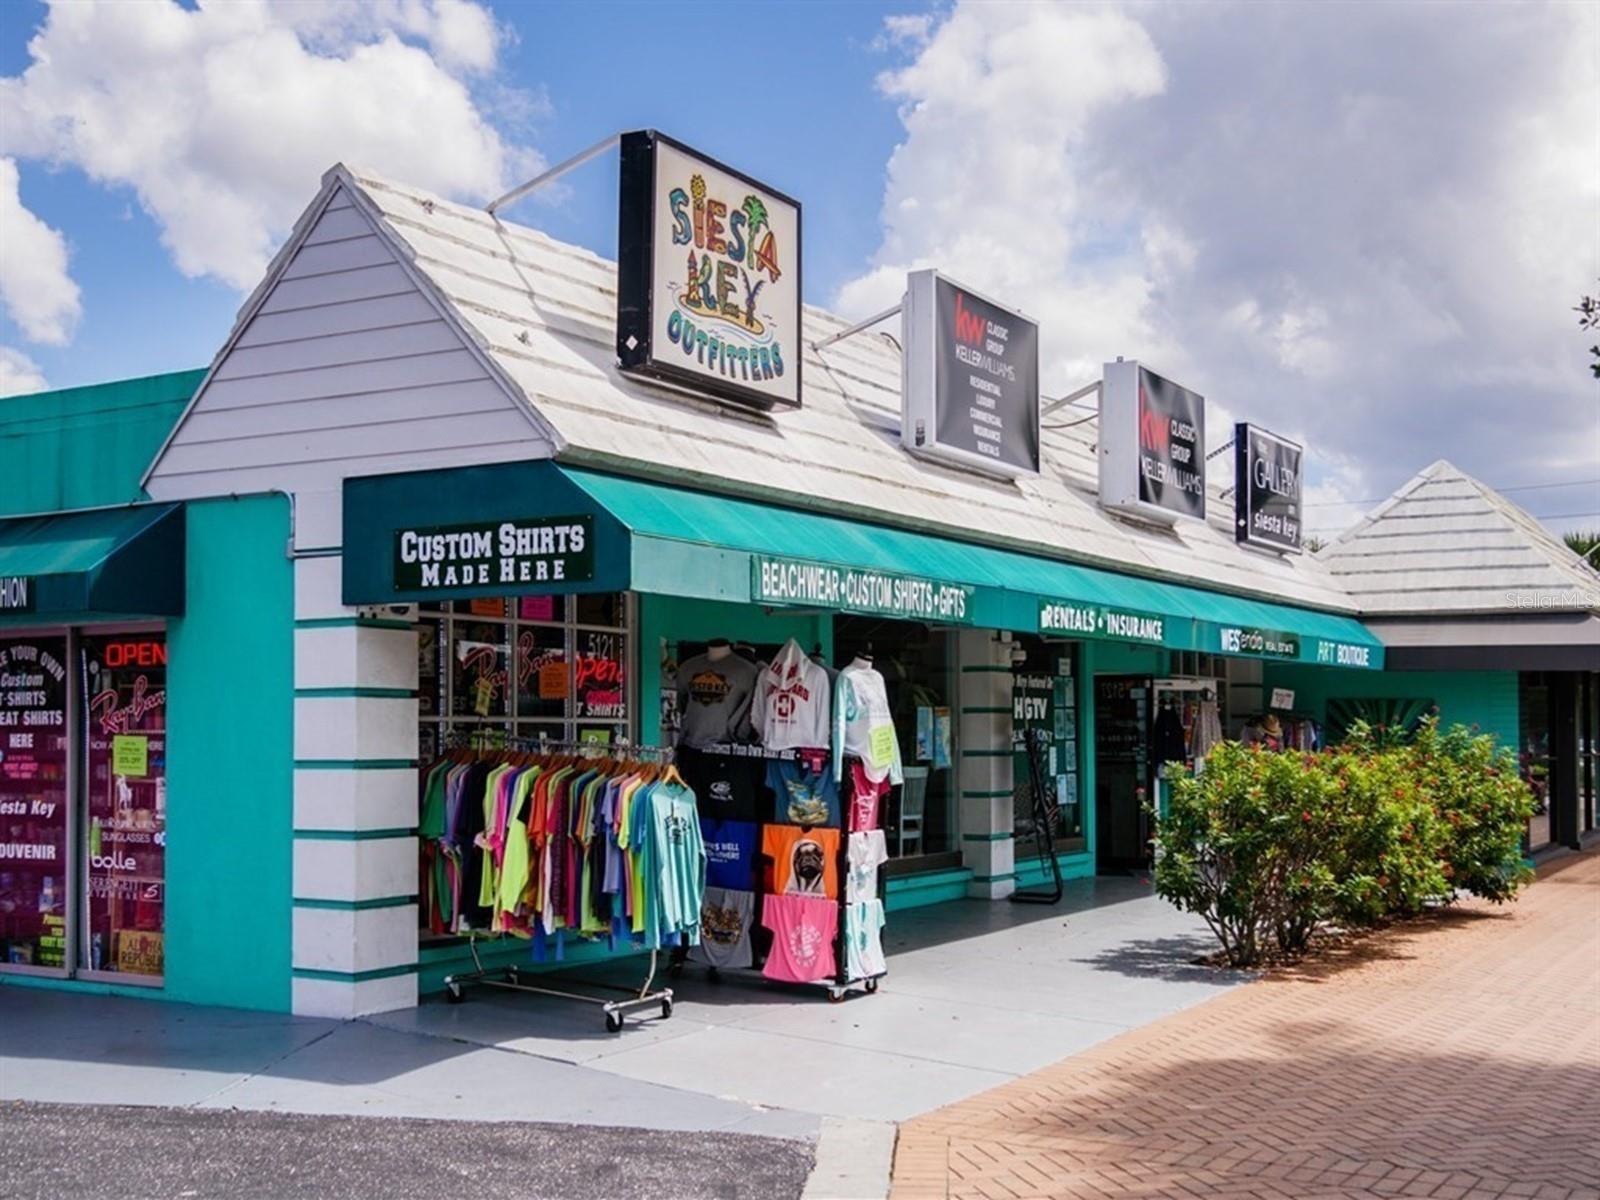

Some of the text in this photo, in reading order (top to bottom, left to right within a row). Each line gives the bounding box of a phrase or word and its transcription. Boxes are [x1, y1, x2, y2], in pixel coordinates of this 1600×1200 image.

[668, 174, 782, 284] SIESTA
[686, 249, 766, 328] KEY
[986, 320, 1009, 342] CLASSIC
[667, 309, 785, 382] OUTFITTERS
[986, 338, 1005, 356] GROUP
[1170, 418, 1197, 443] CLASSIC
[1170, 443, 1192, 464] GROUP
[1253, 508, 1298, 543] siesta key
[846, 572, 893, 609] CUSTOM
[894, 579, 933, 614] SHIRTS
[939, 588, 966, 619] GIFTS
[1045, 604, 1164, 641] RENTALS INSURANCE
[105, 642, 167, 667] OPEN
[588, 633, 614, 660] 5121
[1316, 640, 1370, 667] ART BOUTIQUE
[10, 645, 38, 661] YOUR
[40, 651, 65, 682] OWN
[1, 672, 44, 688] Custom
[23, 709, 63, 726] SHIRTS
[1014, 696, 1049, 719] HGTV
[9, 733, 34, 748] HERE
[31, 800, 56, 818] Key
[102, 831, 151, 844] SUNGLASSES
